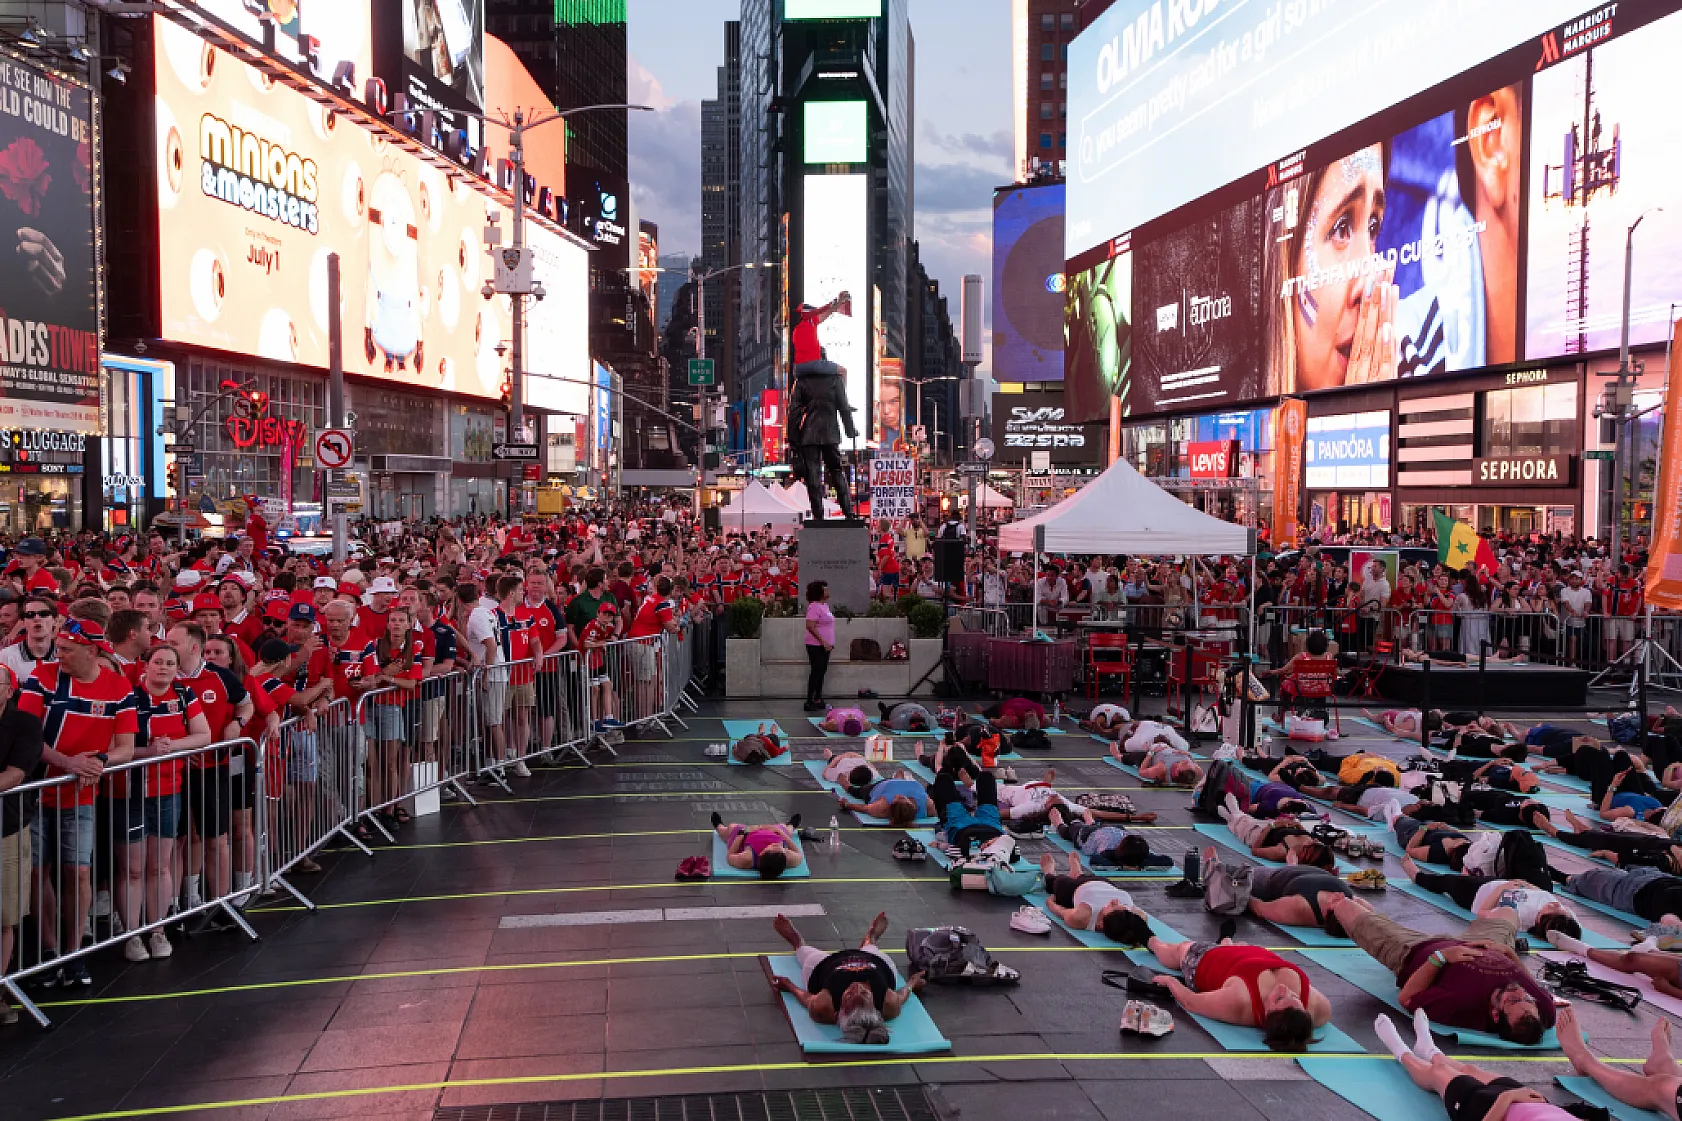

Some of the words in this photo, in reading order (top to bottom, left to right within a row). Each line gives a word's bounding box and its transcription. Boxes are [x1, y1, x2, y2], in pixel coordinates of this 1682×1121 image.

[1563, 3, 1618, 38] MARRIOTT
[1097, 0, 1165, 93] OLIVIA
[1563, 22, 1611, 54] MARQUIS
[14, 66, 32, 93] SEE
[34, 74, 53, 101] HOW
[55, 84, 71, 109] THE
[24, 96, 68, 136] COULD
[247, 244, 273, 275] July
[1346, 248, 1397, 280] WORLD
[1506, 369, 1547, 386] SEPHORA
[23, 430, 86, 452] LUGGAGE
[41, 463, 64, 472] SONY
[874, 461, 910, 470] ONLY
[1480, 460, 1559, 481] SEPHORA
[872, 471, 912, 486] JESUS
[870, 486, 914, 498] FORGIVES
[877, 498, 895, 508] SIN
[900, 498, 908, 508] &
